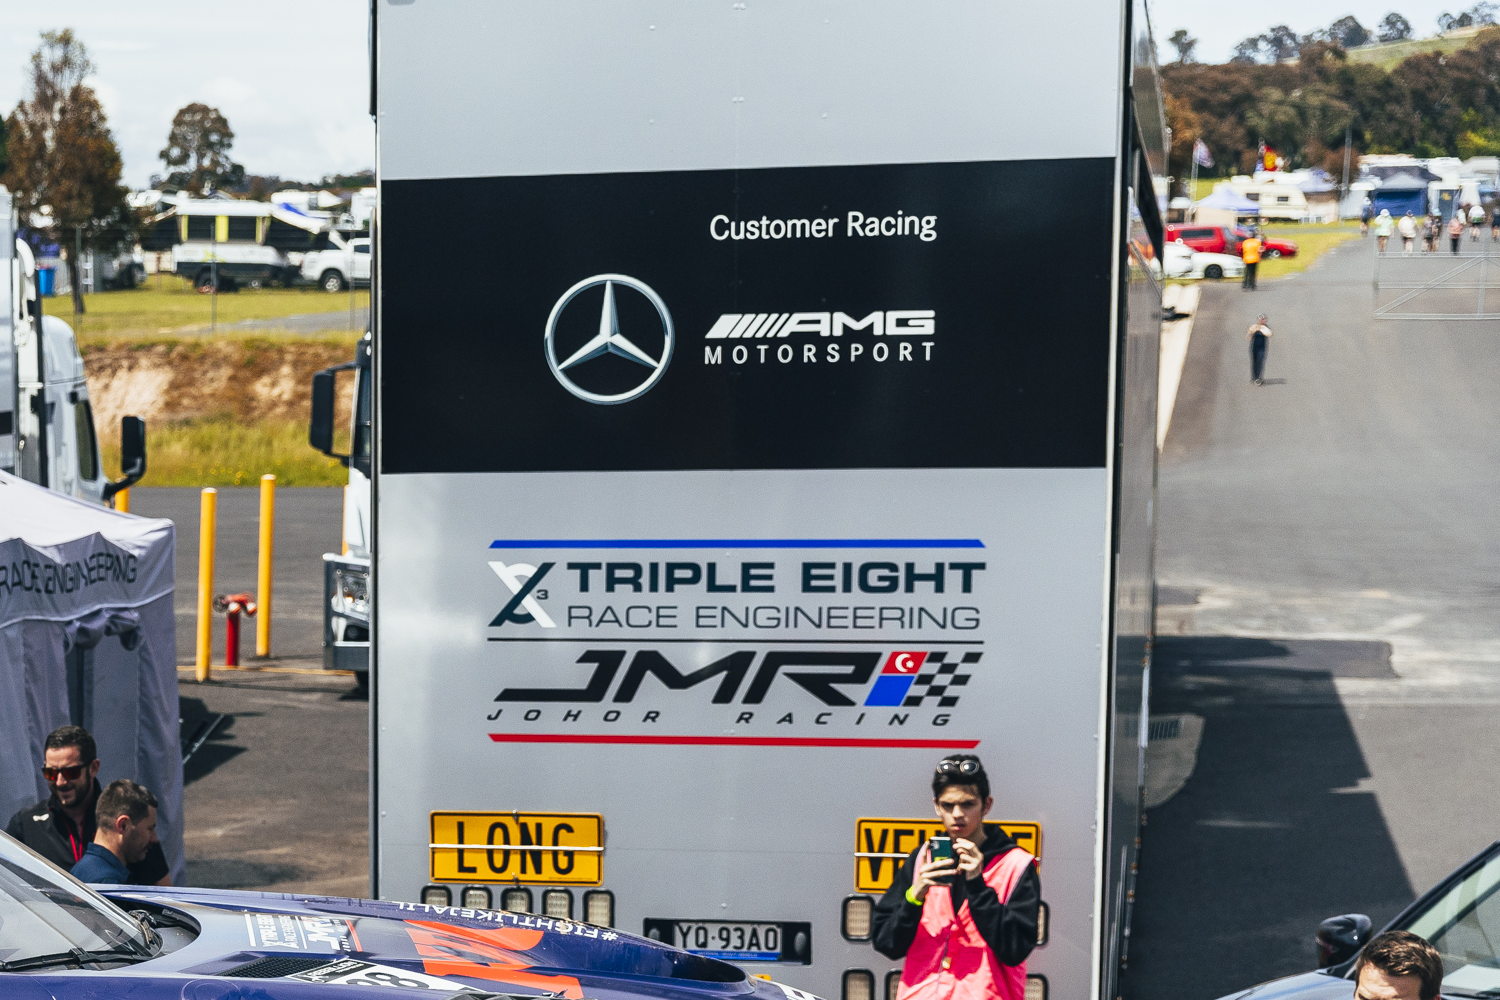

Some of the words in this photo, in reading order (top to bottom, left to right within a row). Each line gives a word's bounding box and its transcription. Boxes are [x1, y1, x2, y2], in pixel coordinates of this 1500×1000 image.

[709, 213, 839, 241] Customer
[846, 211, 938, 242] Racing
[747, 310, 936, 338] AMG
[705, 341, 936, 365] MOTORSPORT
[567, 561, 776, 594] TRIPLE
[802, 561, 987, 595] EIGHT
[567, 605, 678, 629] RACE
[695, 605, 981, 631] ENGINEERING
[494, 649, 883, 707] JMR
[486, 708, 661, 724] JOHOR
[736, 711, 953, 726] RACING
[457, 821, 576, 877] LONG
